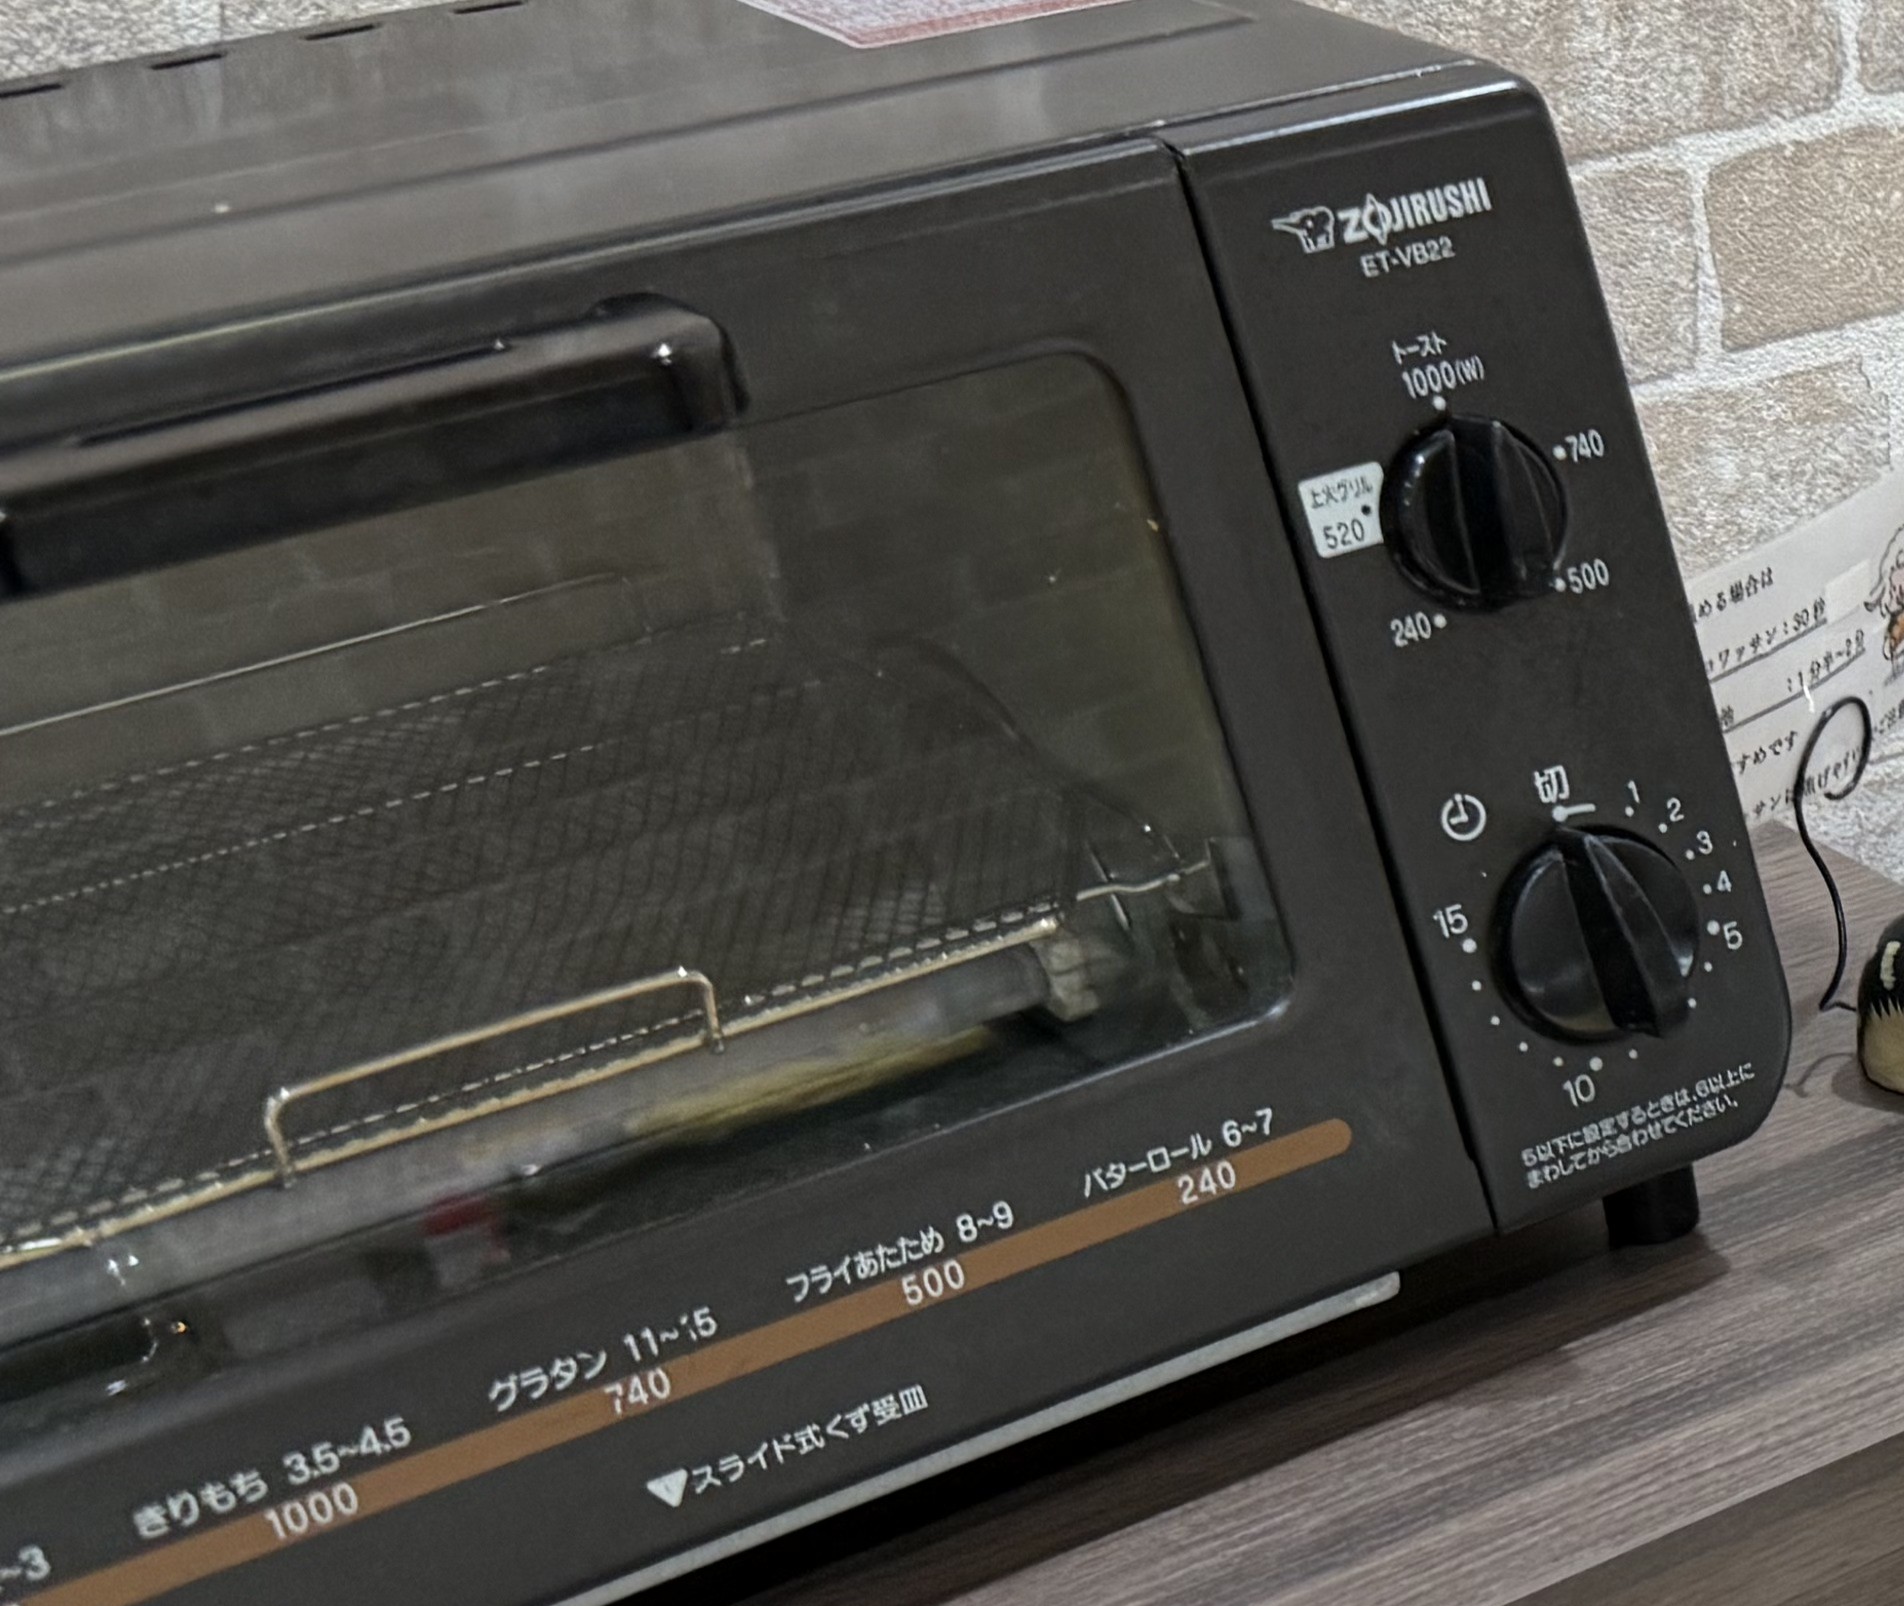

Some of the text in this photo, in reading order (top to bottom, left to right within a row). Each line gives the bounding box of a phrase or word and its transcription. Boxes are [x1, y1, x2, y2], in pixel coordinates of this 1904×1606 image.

[1337, 177, 1492, 245] ZOJIRUSHI
[1361, 236, 1456, 278] ET-VB22
[1393, 331, 1448, 364] トースト
[1402, 357, 1485, 399] 1000(W)
[1565, 429, 1604, 460] 740
[1323, 518, 1365, 550] 520
[1569, 559, 1610, 593] 500
[1391, 612, 1432, 647] 240
[1534, 765, 1571, 804] 切
[1627, 781, 1641, 803] 1
[1666, 797, 1685, 822] 2
[1696, 831, 1714, 855] 3
[1716, 870, 1733, 893] 4
[1433, 904, 1468, 939] 15
[1723, 922, 1744, 950] 5
[1563, 1074, 1597, 1108] 10
[1083, 1131, 1213, 1199] バターロール
[1177, 1161, 1237, 1205] 240
[786, 1227, 945, 1304] フライあたため
[902, 1260, 966, 1307] 500
[488, 1349, 607, 1413] グラタン
[603, 1367, 671, 1419] 740
[691, 1383, 929, 1496] スライド式くず受皿
[133, 1467, 269, 1540] きりもち
[264, 1481, 360, 1541] 1000
